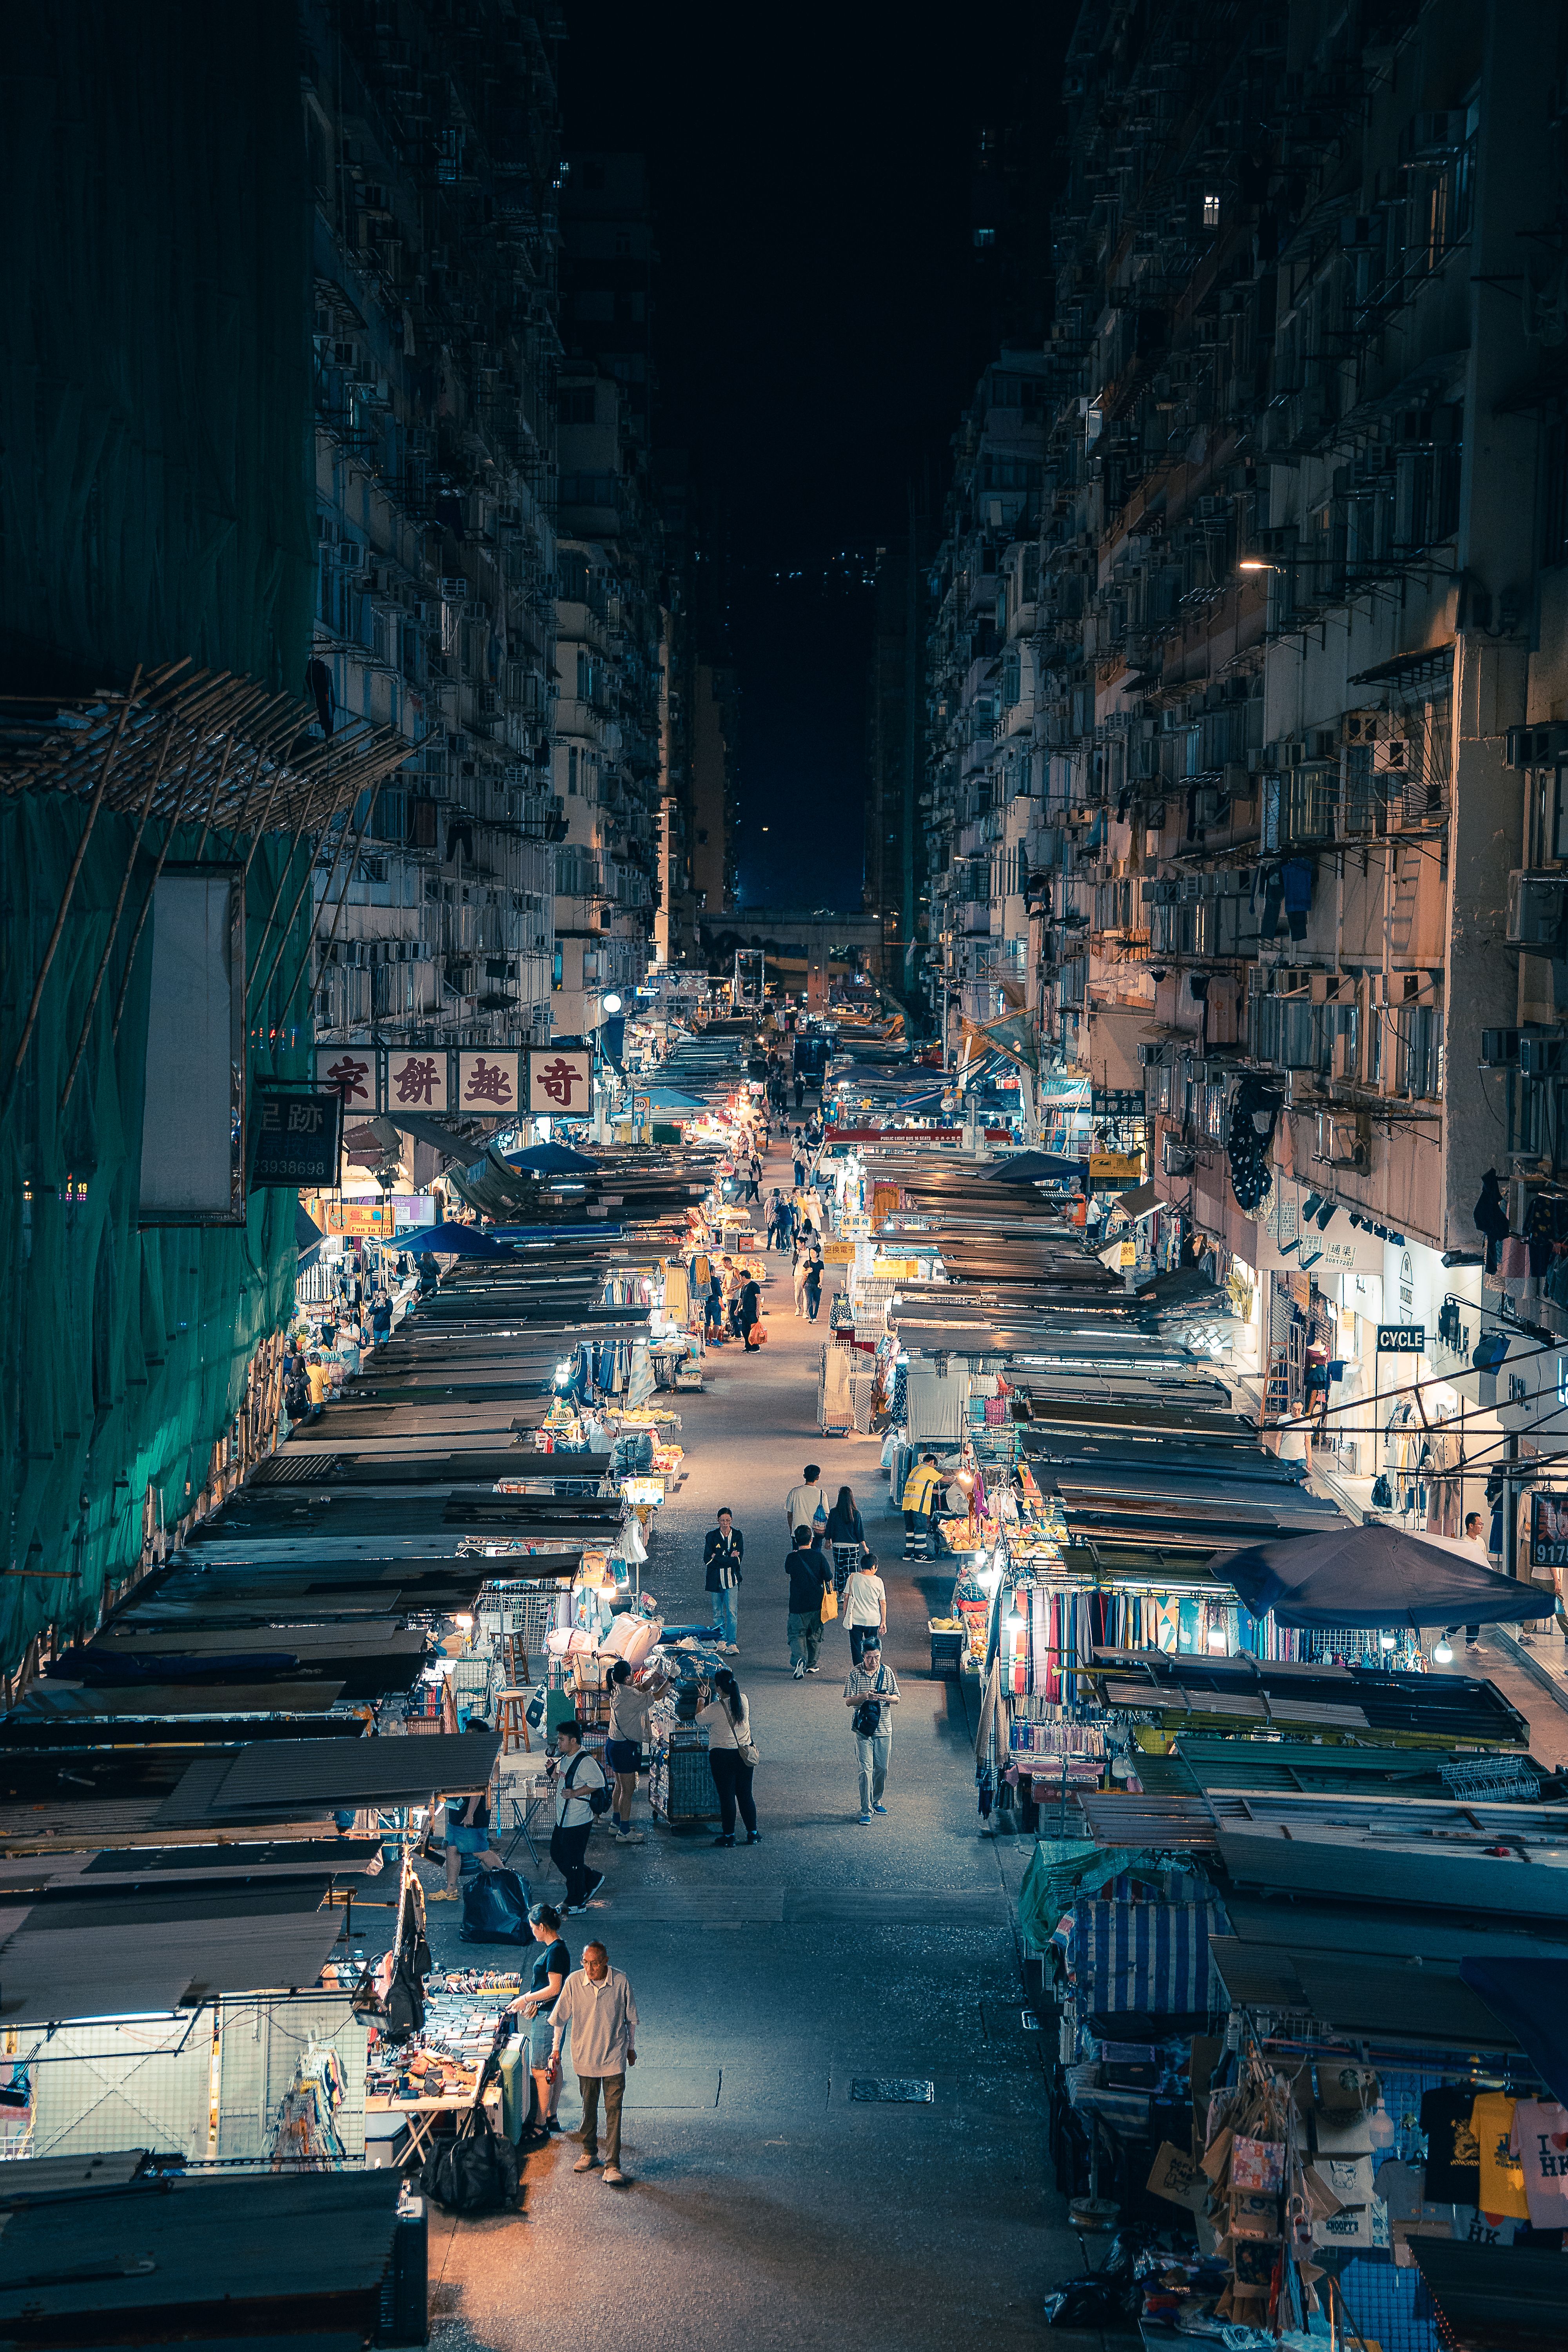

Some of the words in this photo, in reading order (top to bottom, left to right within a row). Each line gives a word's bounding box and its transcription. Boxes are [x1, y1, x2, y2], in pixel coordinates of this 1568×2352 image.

[350, 1210, 392, 1221] 生活色彩
[1330, 1244, 1351, 1256] 通渠
[1325, 1257, 1353, 1267] 90817280
[1380, 1332, 1423, 1347] CYCLE
[1537, 1544, 1568, 1562] 917
[1539, 2156, 1568, 2177] HK
[1468, 2224, 1501, 2244] HK
